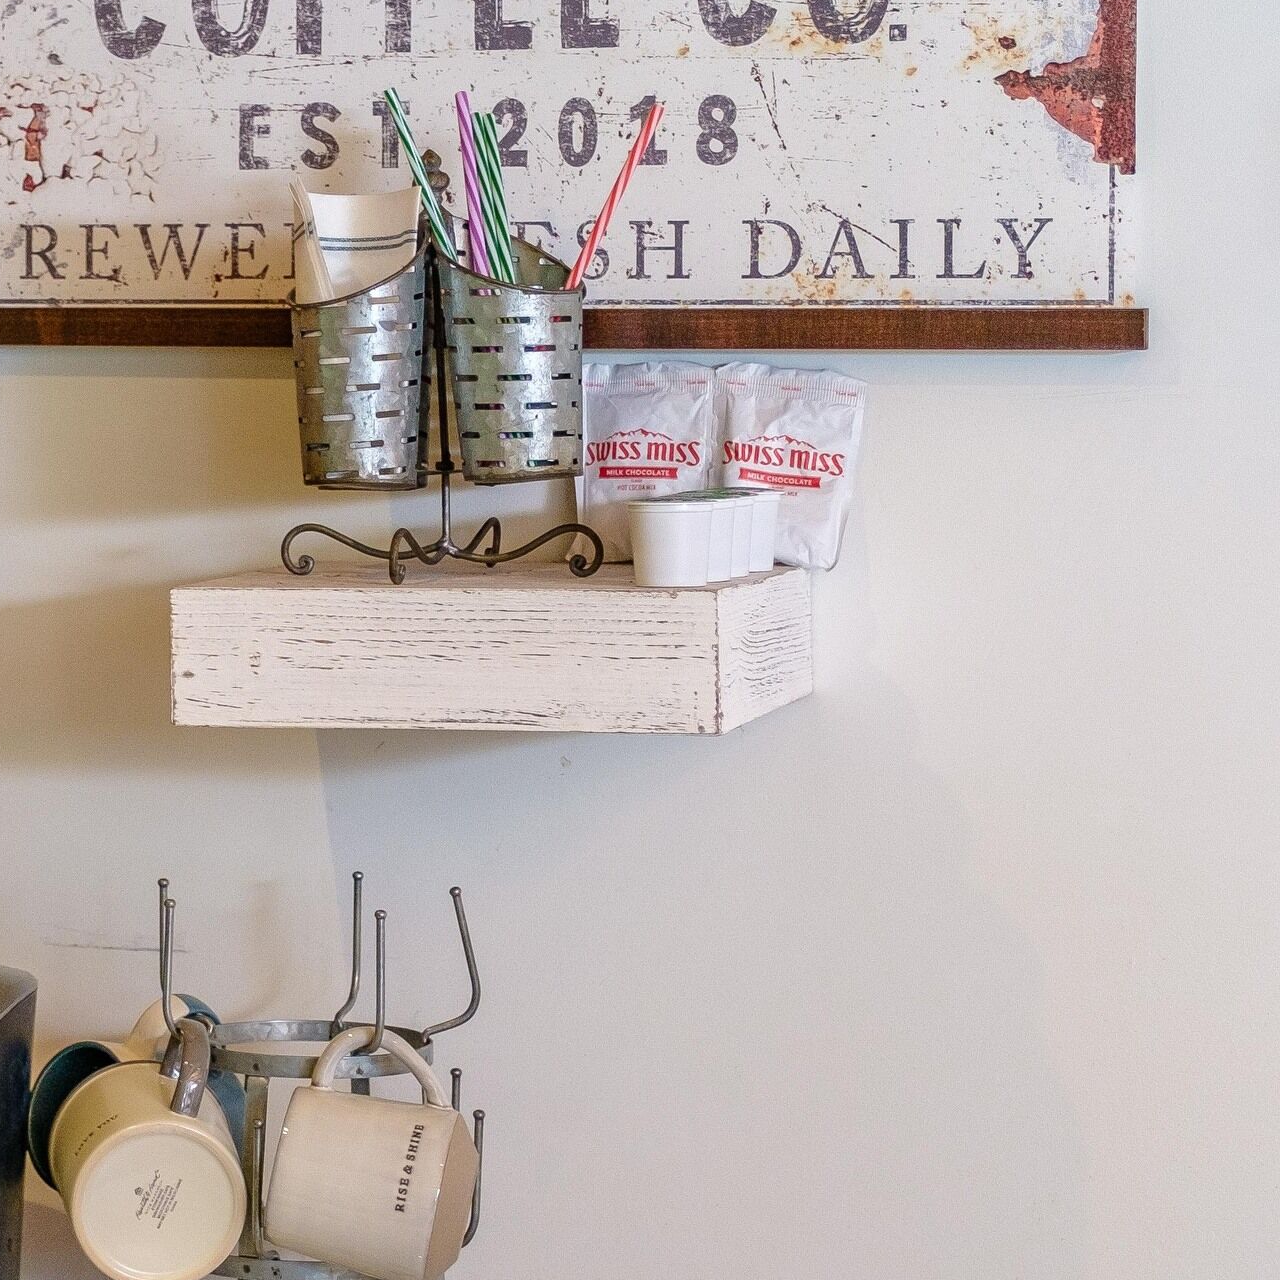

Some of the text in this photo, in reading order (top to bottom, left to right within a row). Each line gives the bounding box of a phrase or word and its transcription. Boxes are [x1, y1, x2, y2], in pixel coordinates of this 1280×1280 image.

[741, 219, 1053, 280] DAILY
[586, 441, 641, 466] SWISS
[723, 440, 784, 466] SWISS
[625, 468, 670, 476] CHOCOLATE
[747, 471, 813, 486] MILK CHOCOLATE
[395, 1124, 424, 1212] RISE & SHINE
